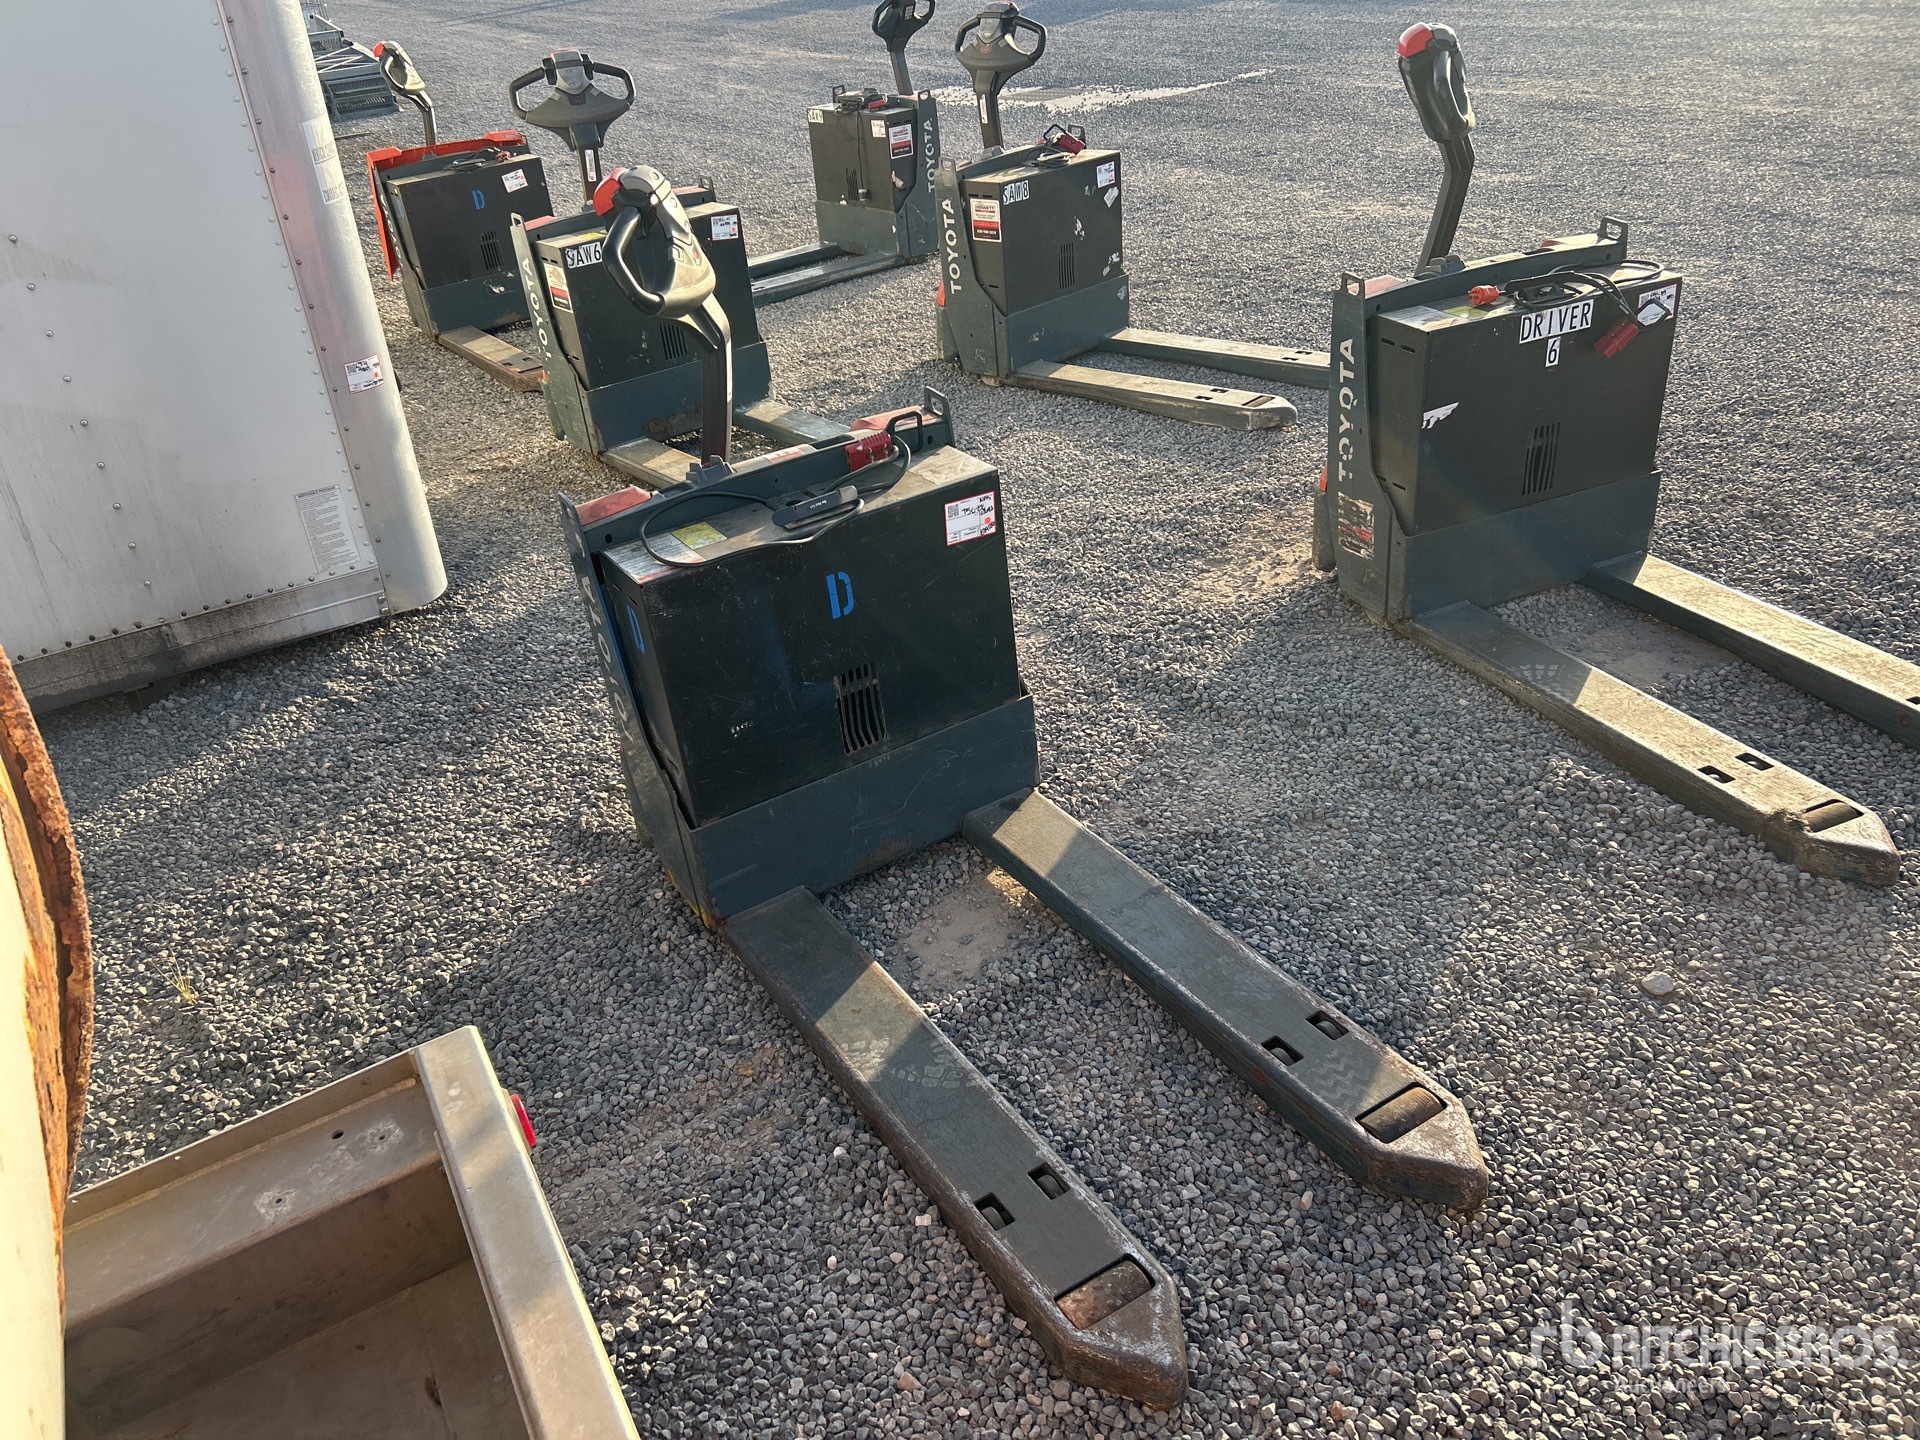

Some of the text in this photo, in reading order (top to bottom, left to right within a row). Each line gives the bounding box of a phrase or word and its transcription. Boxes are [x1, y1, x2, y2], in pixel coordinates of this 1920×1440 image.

[923, 118, 936, 193] TOYOTA
[472, 189, 485, 210] D
[566, 243, 601, 267] SAW6
[942, 198, 962, 295] TOYOTA
[521, 257, 552, 362] TOYOTA
[1520, 302, 1591, 342] DRIVER
[1547, 339, 1558, 364] 6
[1338, 338, 1357, 483] TOYOTA
[826, 572, 855, 619] D
